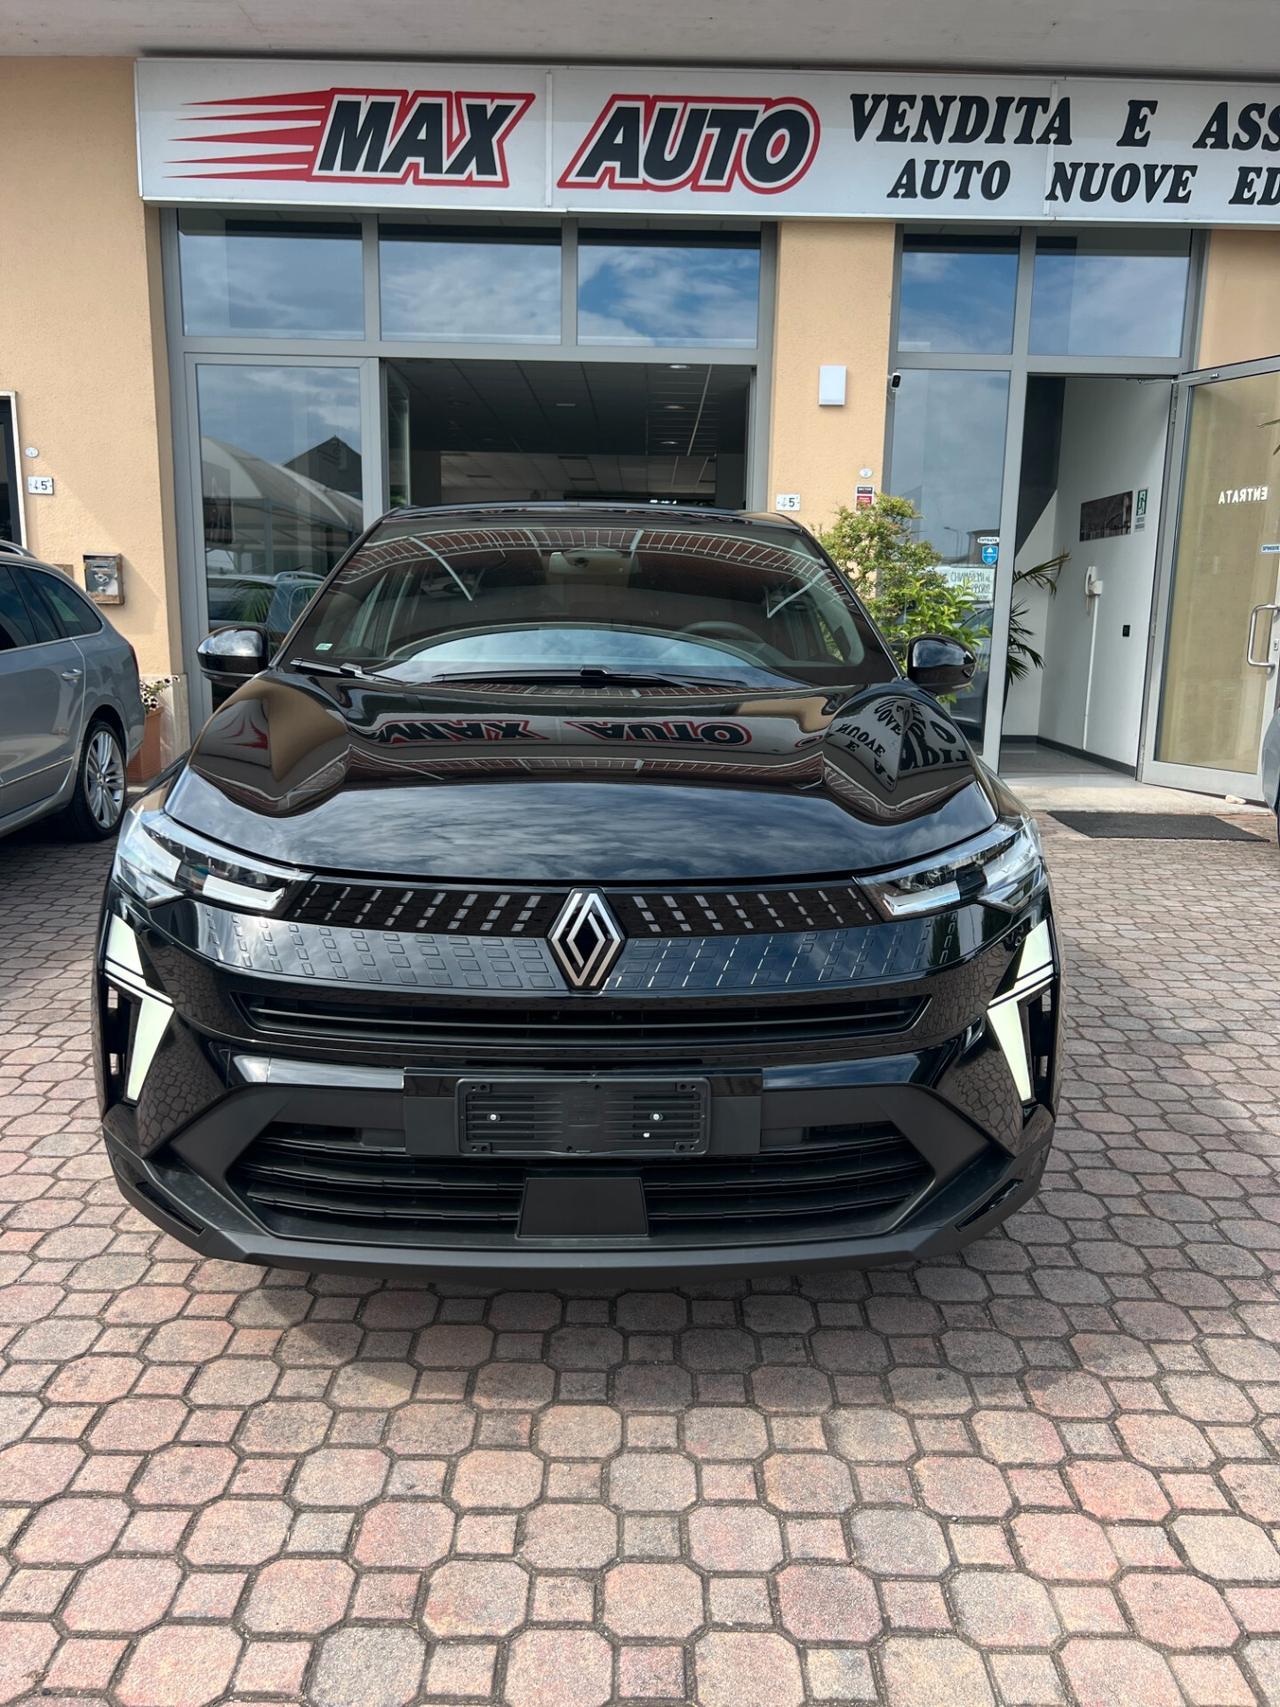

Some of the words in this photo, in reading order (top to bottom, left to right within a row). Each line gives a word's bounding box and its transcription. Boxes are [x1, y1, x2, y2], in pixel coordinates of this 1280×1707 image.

[311, 93, 527, 183] MAX
[566, 99, 816, 190] AUTO
[850, 93, 1072, 146] VENDITA
[1116, 99, 1158, 147] E
[887, 158, 1011, 201] AUTO
[1045, 161, 1198, 204] NUOVE
